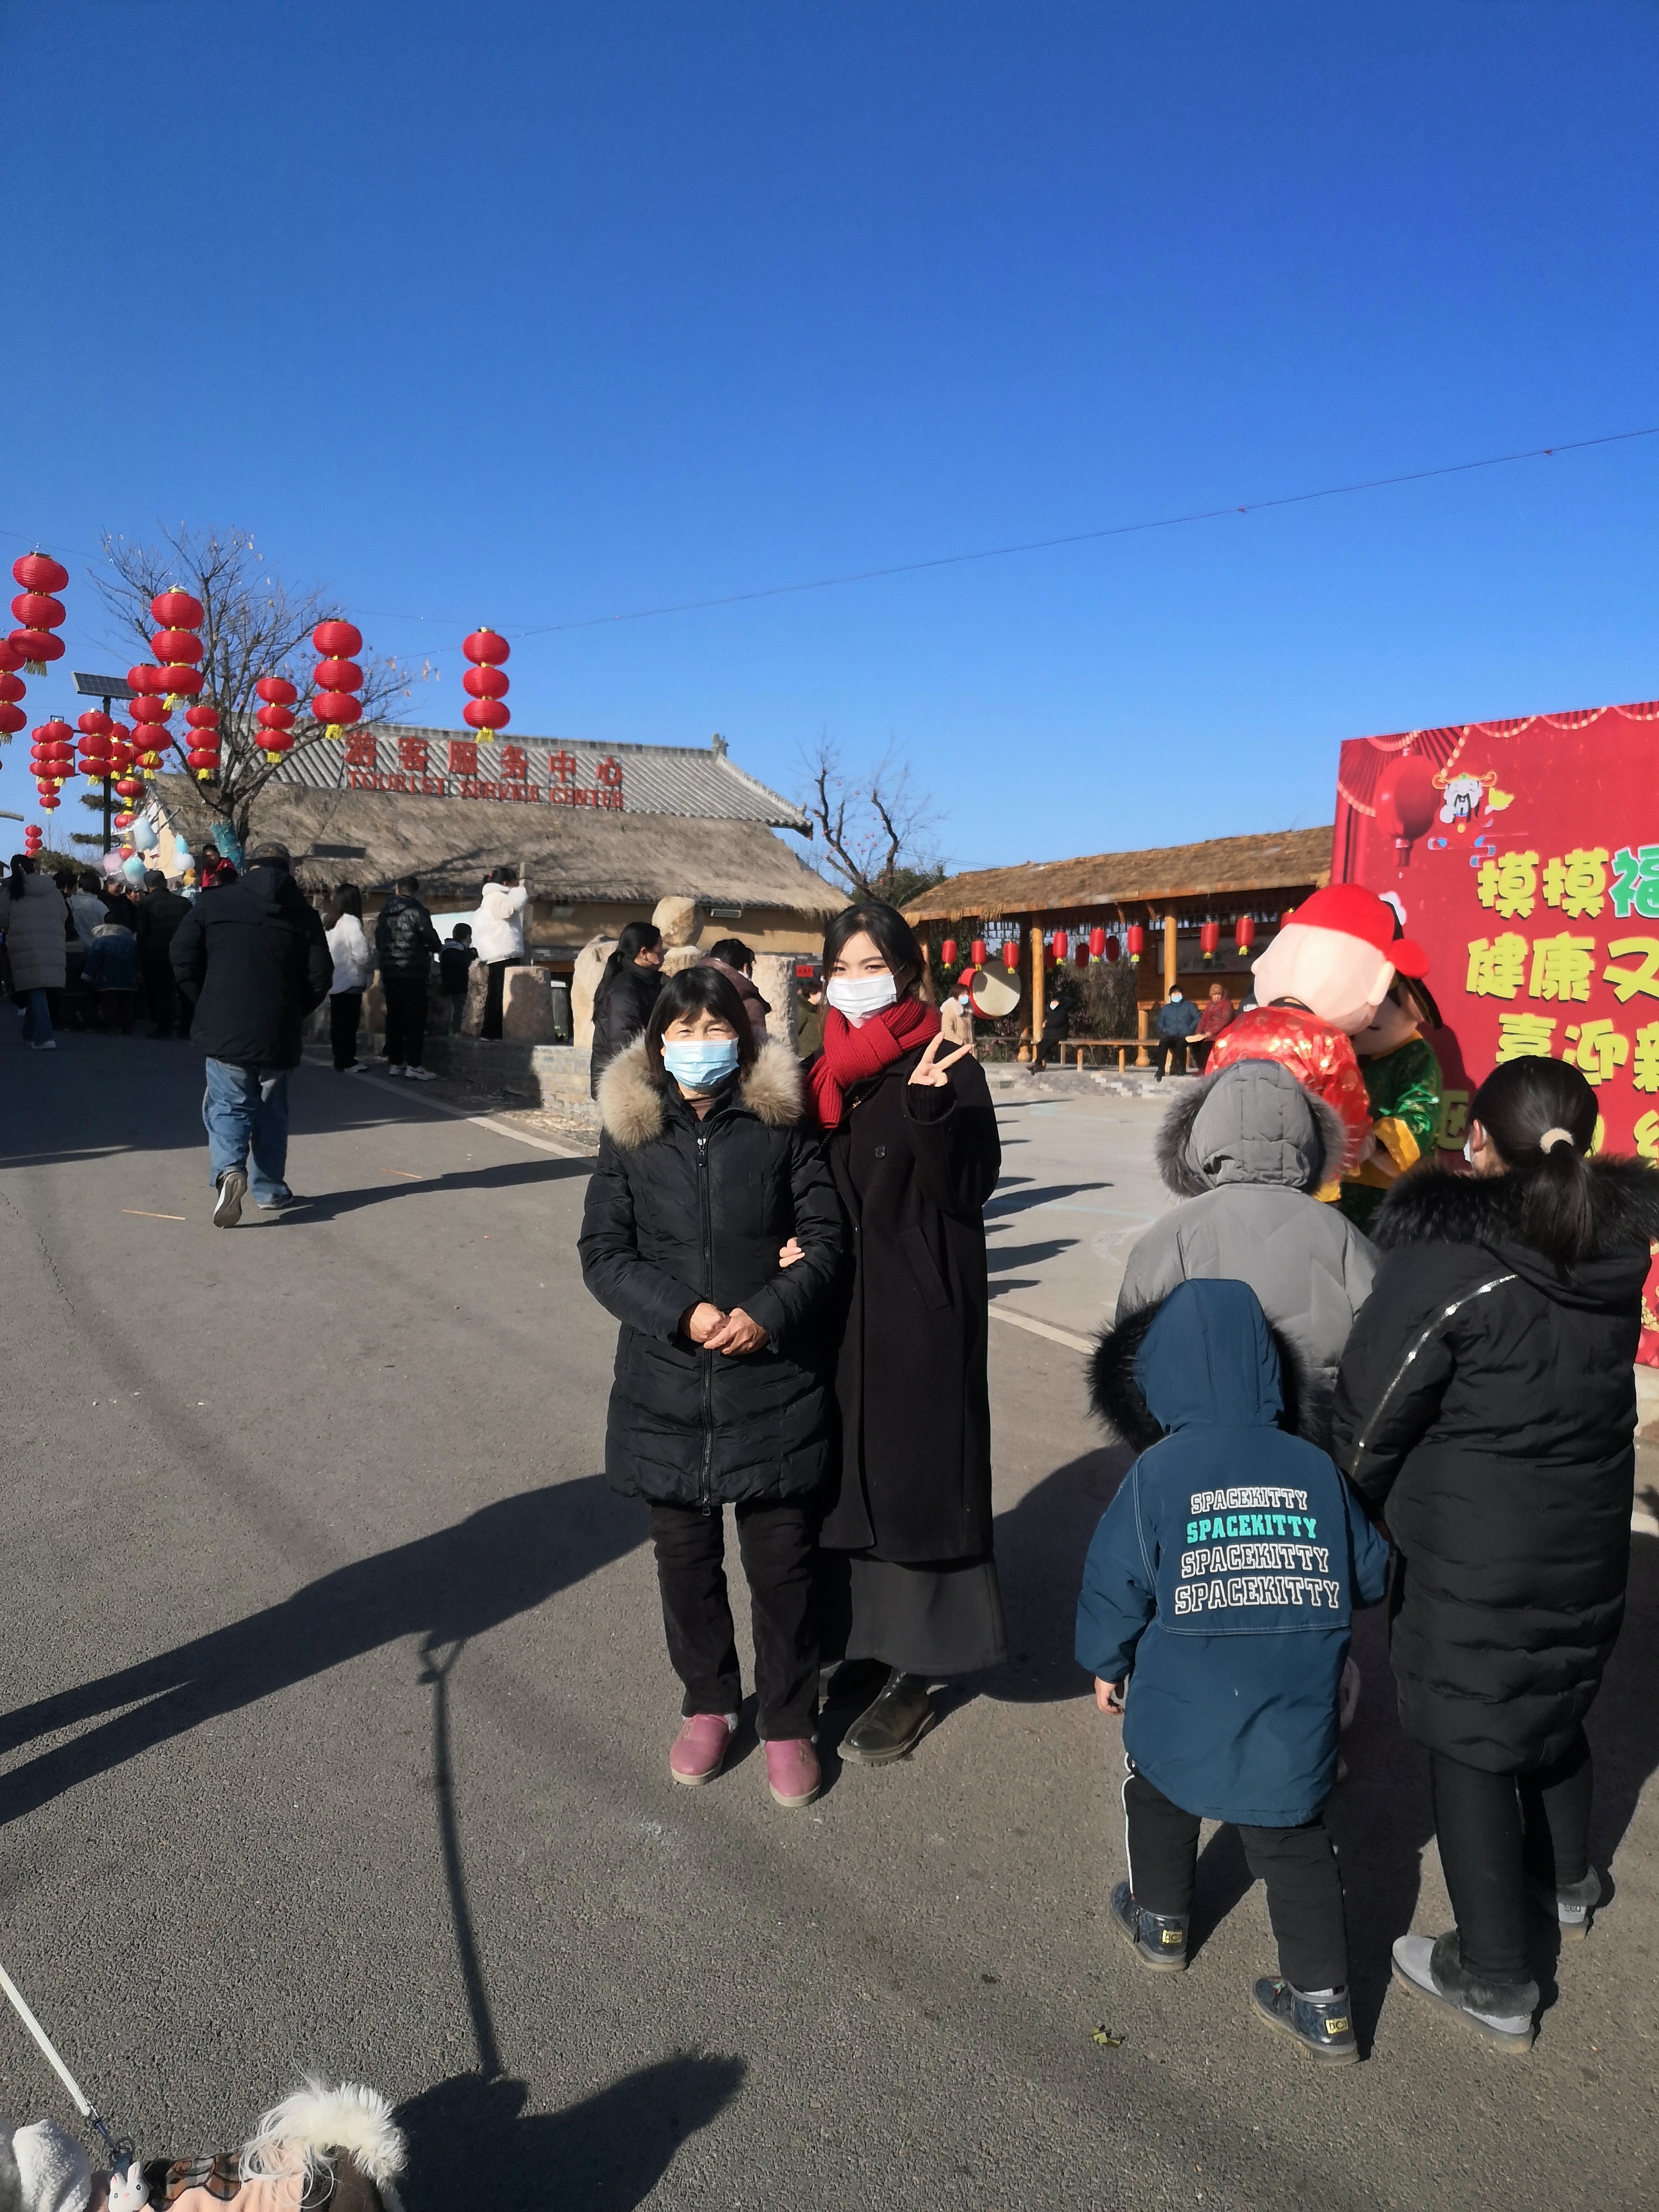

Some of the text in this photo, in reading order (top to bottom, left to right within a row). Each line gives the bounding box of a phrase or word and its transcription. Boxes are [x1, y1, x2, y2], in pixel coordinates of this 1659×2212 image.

[340, 729, 623, 786] 游客服务中心
[346, 769, 623, 811] TOURIST SERVICE CENTER
[1477, 844, 1659, 919] 摸摸福
[1466, 931, 1659, 1003] 健康又
[1191, 1486, 1308, 1515] SPACEKITTY
[1187, 1514, 1317, 1544] SPACEKITTY
[1181, 1543, 1329, 1579] SPACEKITTY
[1175, 1576, 1340, 1615] SPACEKITTY
